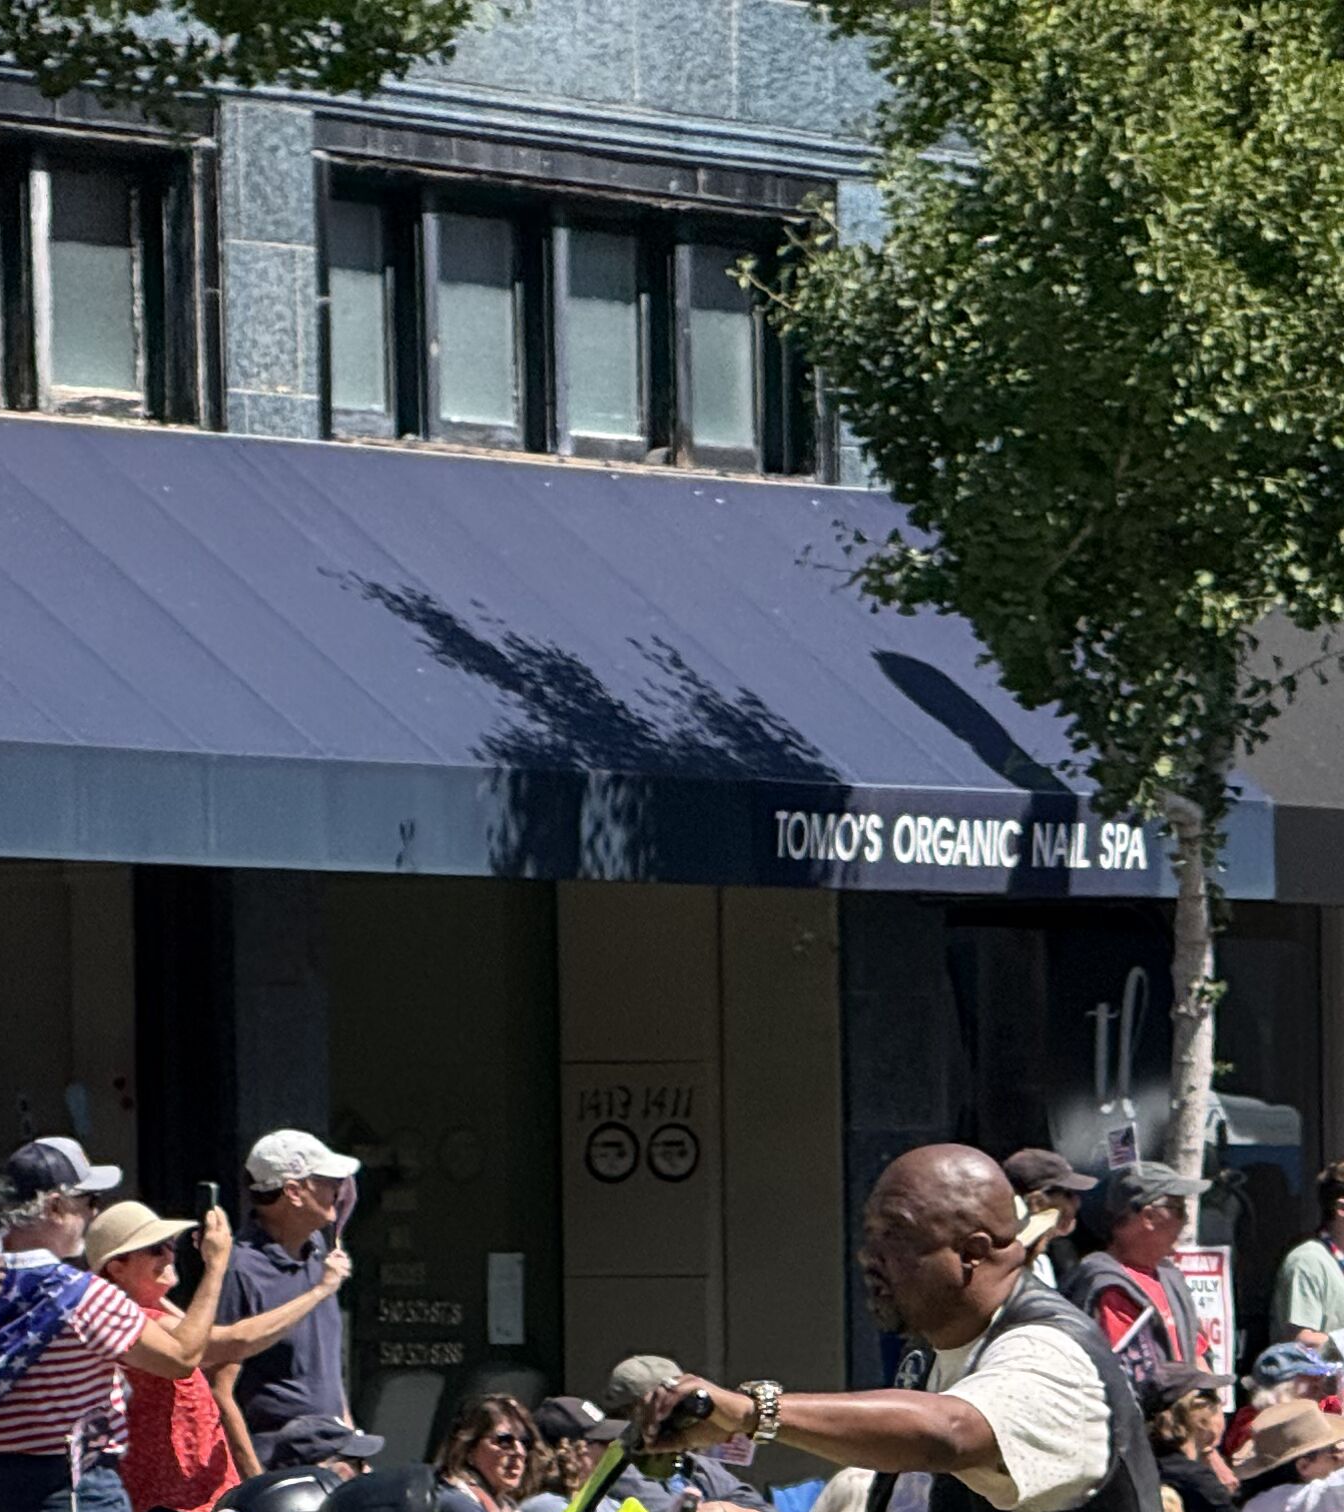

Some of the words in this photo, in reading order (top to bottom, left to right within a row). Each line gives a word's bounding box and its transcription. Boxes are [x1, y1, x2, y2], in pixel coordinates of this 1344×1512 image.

[775, 810, 882, 862] TOMO'S
[893, 814, 1022, 868] ORGANIC
[1032, 822, 1091, 869] NAIL
[1100, 823, 1148, 870] SPA
